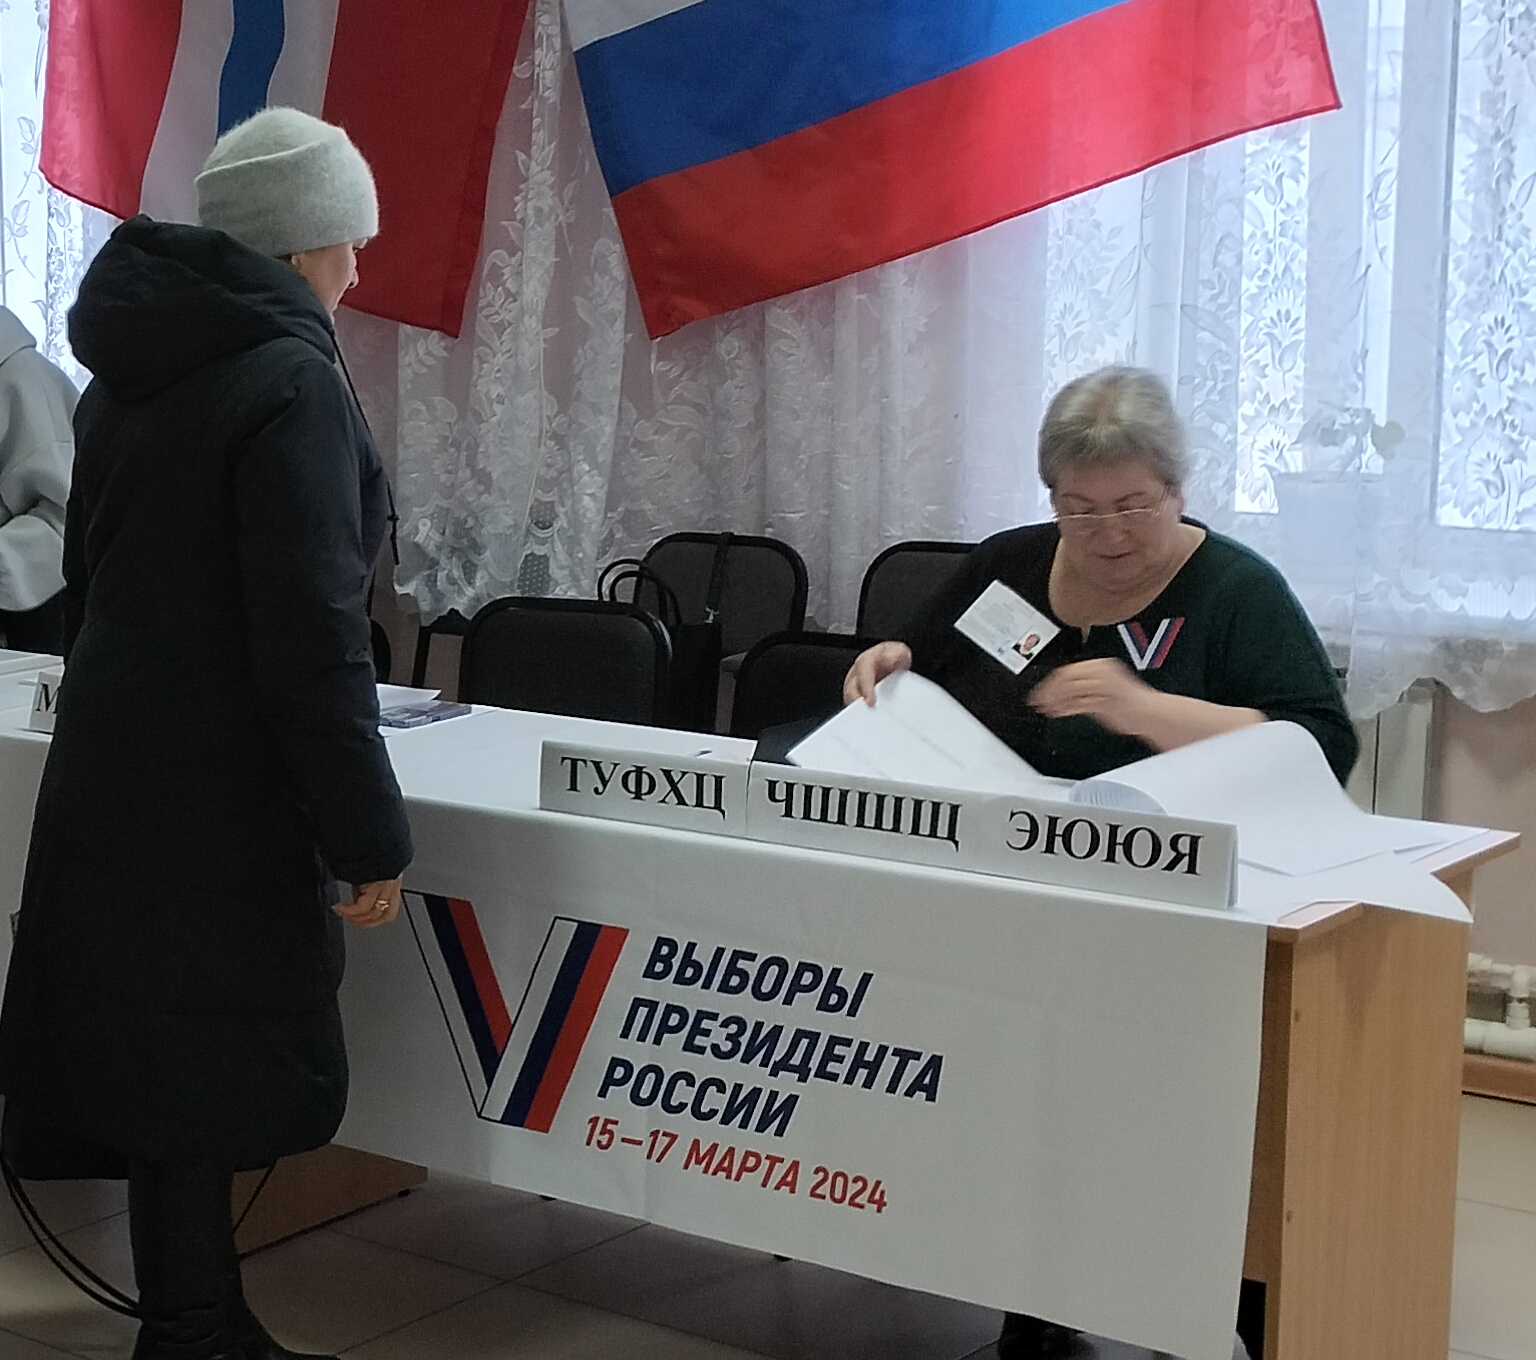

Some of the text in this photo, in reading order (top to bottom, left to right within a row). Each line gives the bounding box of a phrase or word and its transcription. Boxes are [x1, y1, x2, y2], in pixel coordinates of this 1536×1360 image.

[561, 757, 727, 821] ТУФХЦ
[765, 778, 1204, 876] ЧШШЩ ЭЮЮЯ
[642, 936, 874, 1018] ВЫБОРЫ
[619, 997, 945, 1102] ПРЕЗИДЕНТА
[597, 1056, 800, 1137] РОССИИ
[683, 1138, 801, 1194] МАРТА
[810, 1166, 888, 1213] 2024
